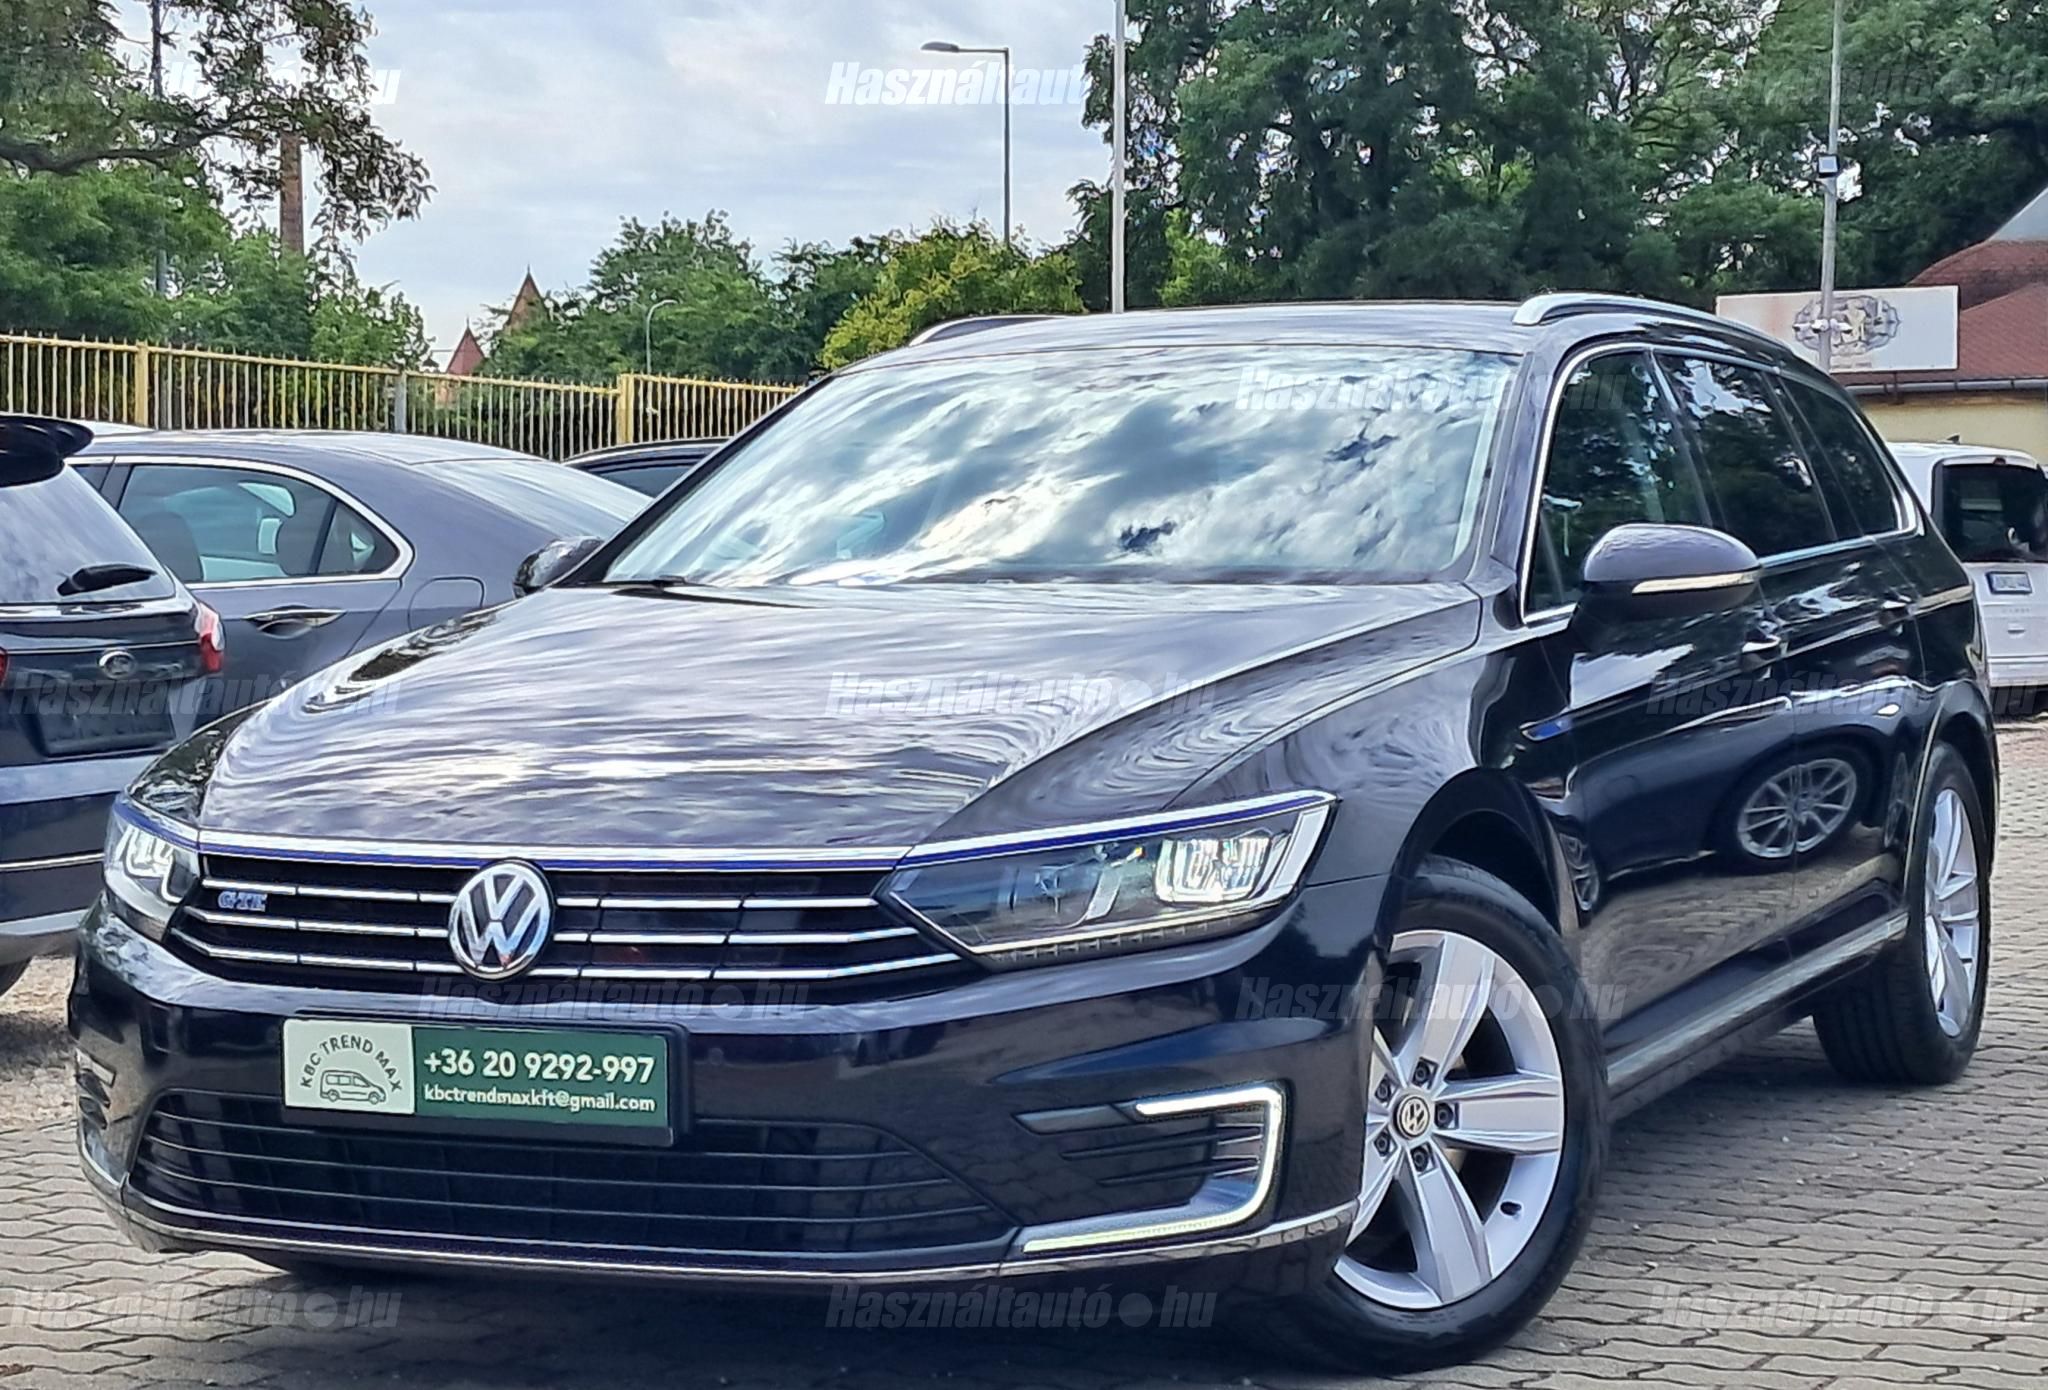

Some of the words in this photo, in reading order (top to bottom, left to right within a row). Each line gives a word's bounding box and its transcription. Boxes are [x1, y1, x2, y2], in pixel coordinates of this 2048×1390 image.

[217, 890, 268, 912] GTE
[300, 1052, 322, 1089] KBC
[319, 1034, 374, 1056] TREND
[375, 1050, 403, 1093] MAX
[423, 1048, 475, 1076] +36
[482, 1050, 517, 1078] 20
[524, 1051, 656, 1084] 9292-997
[424, 1083, 656, 1112] kbctrendmaxkft@gmail.com
